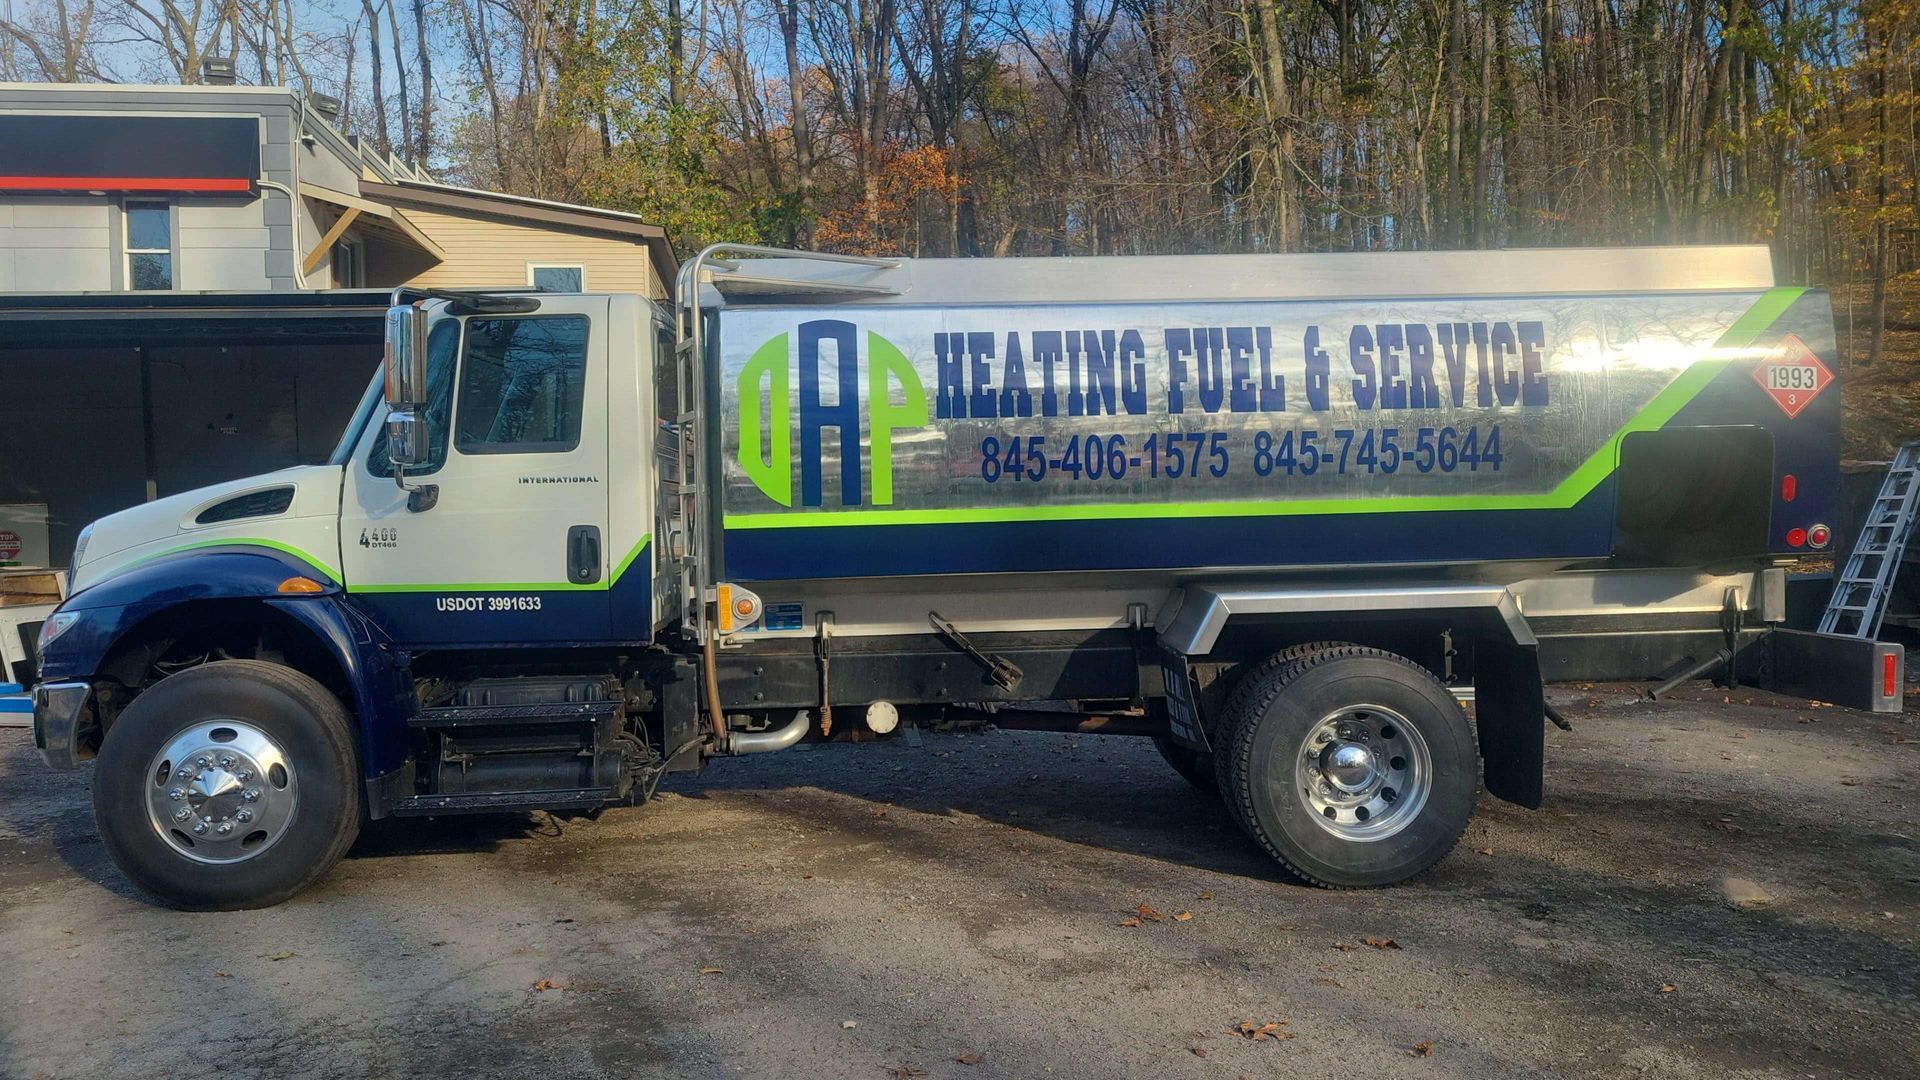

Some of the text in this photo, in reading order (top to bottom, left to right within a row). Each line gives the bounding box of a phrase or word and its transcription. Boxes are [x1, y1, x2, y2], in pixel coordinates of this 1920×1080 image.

[934, 321, 1550, 419] HEATING FUEL & SERVICE
[1770, 367, 1815, 389] 1993
[1787, 393, 1797, 405] 3
[737, 320, 929, 507] DAP
[981, 426, 1504, 483] 845-406-1575 845-745-5644
[518, 475, 599, 485] INTERNATIONAL
[359, 527, 397, 548] 4400
[436, 596, 542, 611] USDOT 3991633
